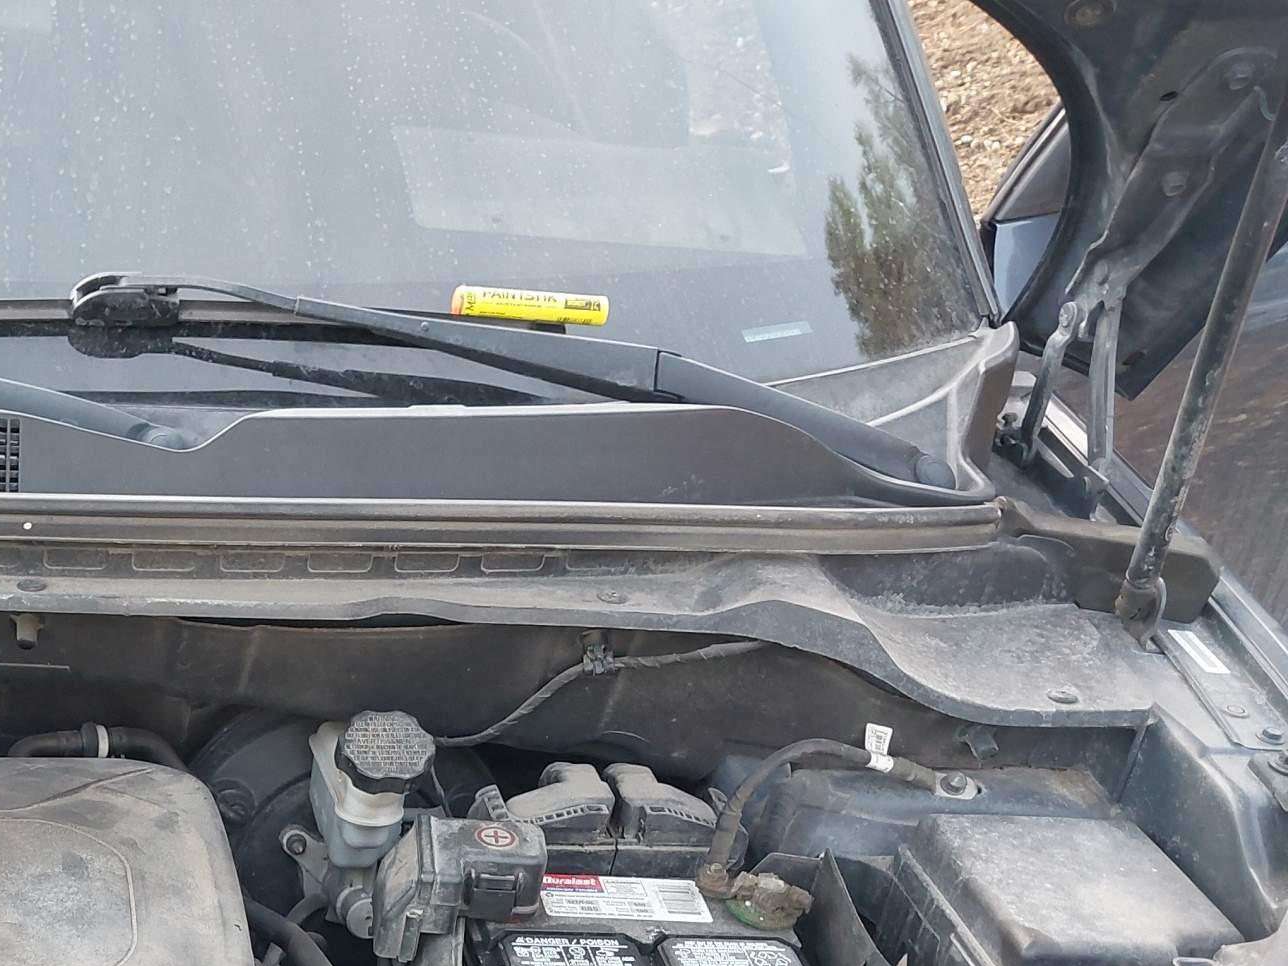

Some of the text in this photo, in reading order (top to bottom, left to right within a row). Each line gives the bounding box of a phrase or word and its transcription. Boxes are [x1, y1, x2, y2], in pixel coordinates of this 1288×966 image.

[542, 875, 597, 886] Duralast
[525, 937, 570, 946] DANGER
[579, 938, 620, 947] POISON
